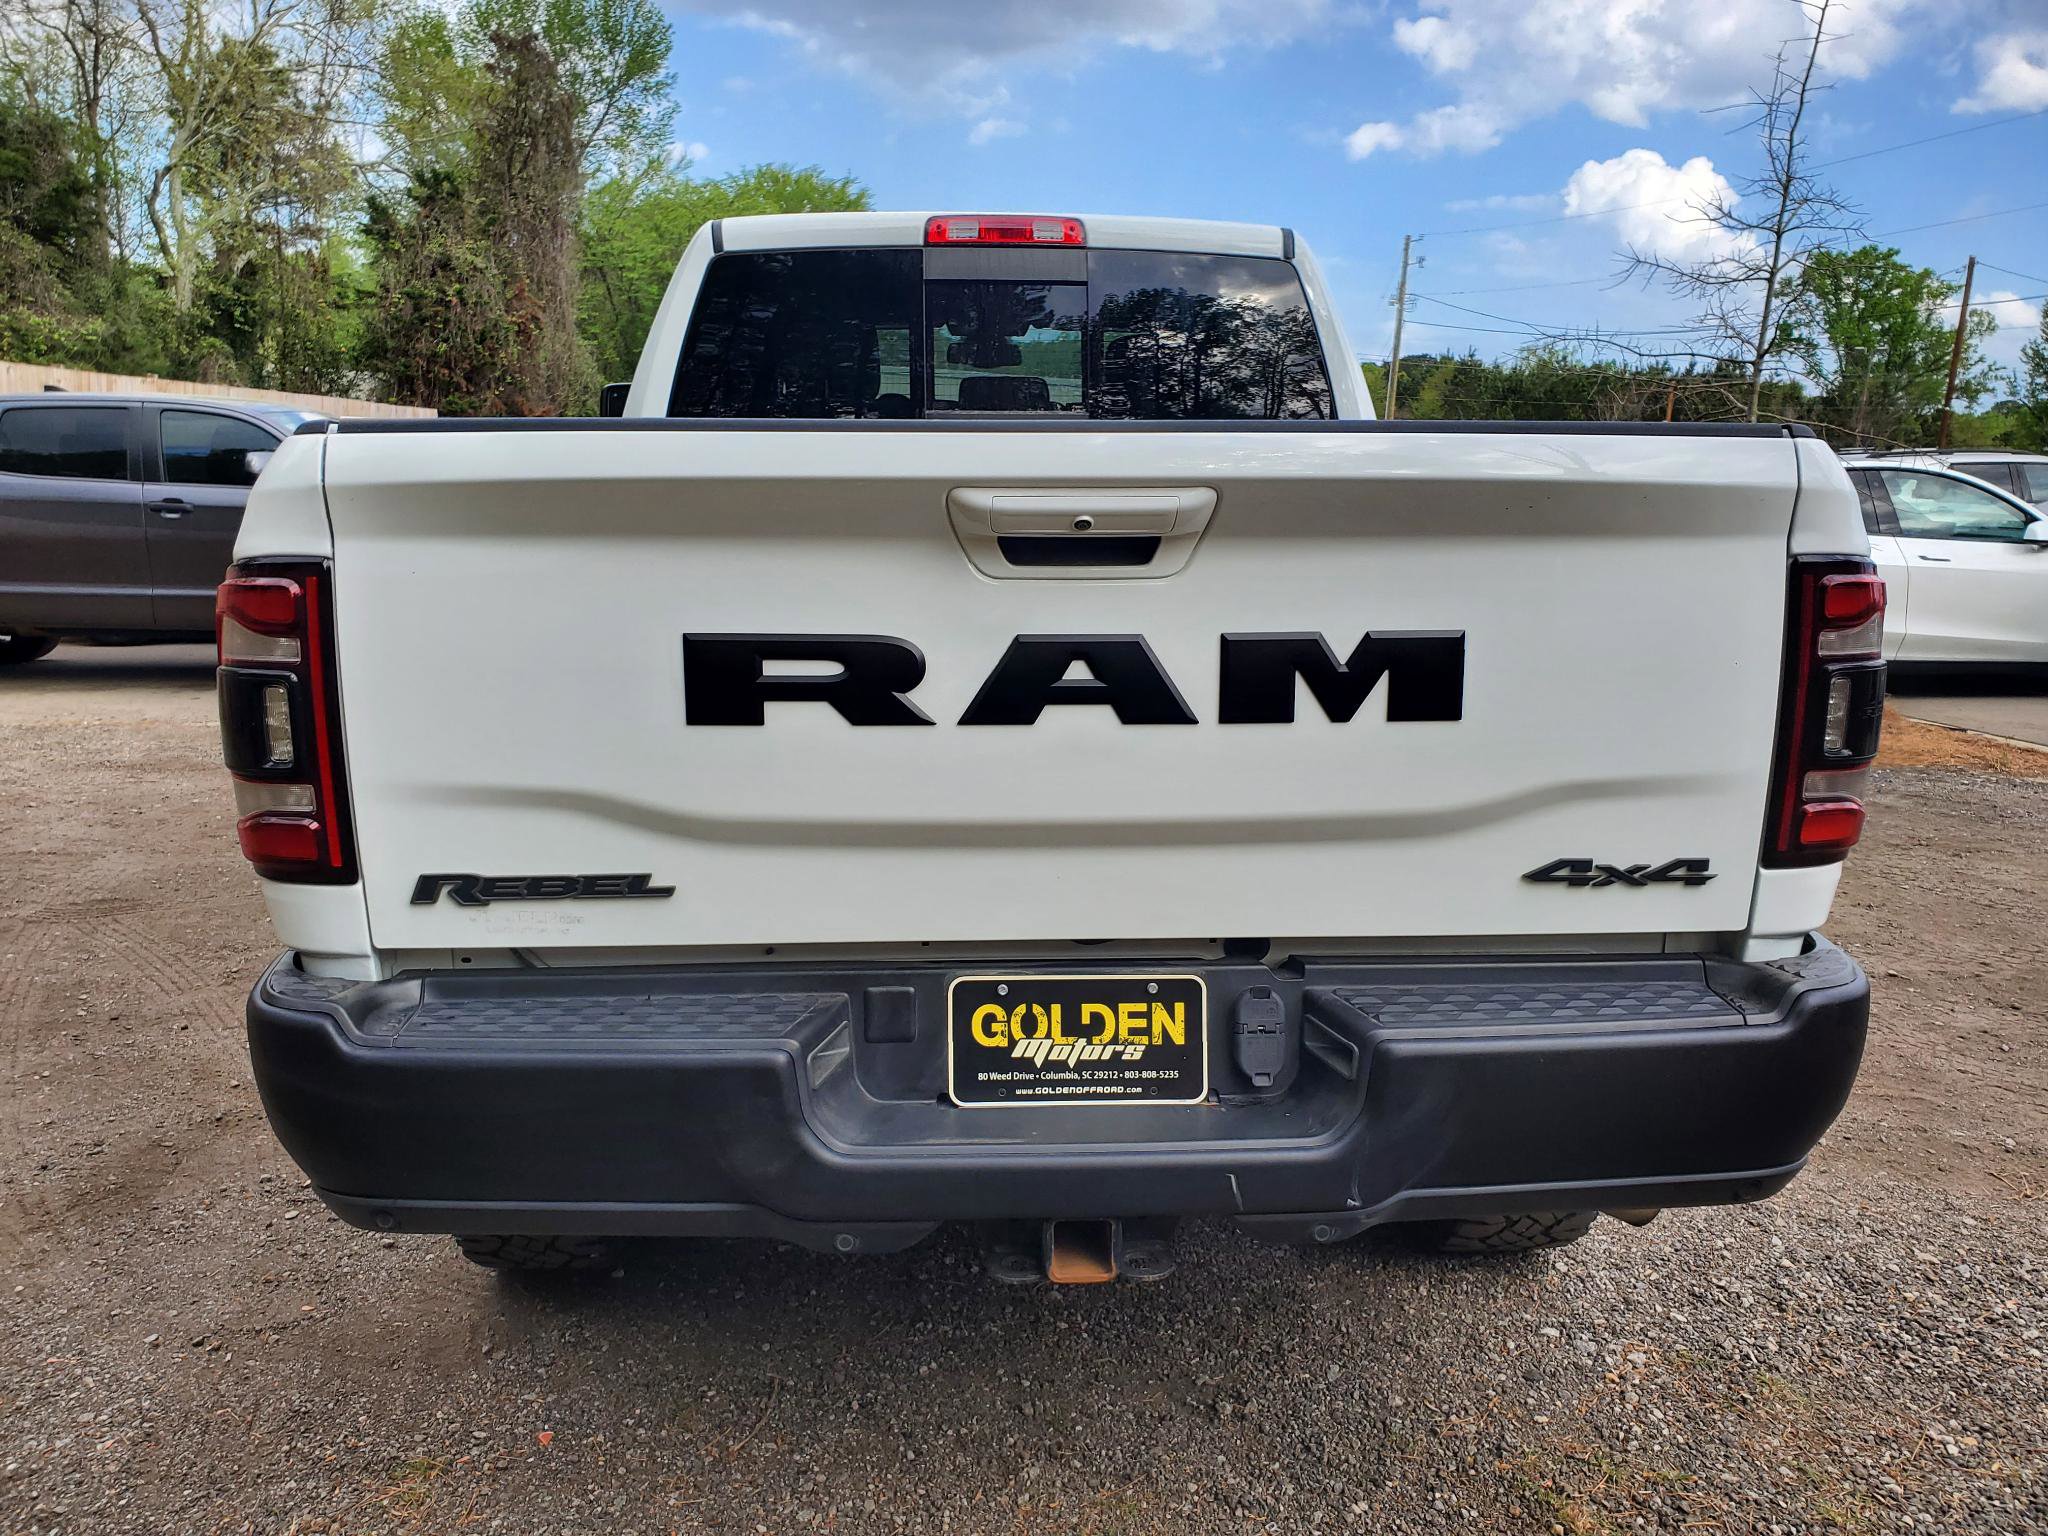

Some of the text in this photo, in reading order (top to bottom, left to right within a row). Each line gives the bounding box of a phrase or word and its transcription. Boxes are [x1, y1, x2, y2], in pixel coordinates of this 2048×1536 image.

[683, 630, 1466, 727] RAM
[410, 873, 676, 905] REBEL
[971, 1002, 1185, 1047] GOLDEN
[1011, 1038, 1147, 1069] Motors
[977, 1070, 1180, 1081] 80 Weed Drive Columbia, SC 29212 803-808-5235
